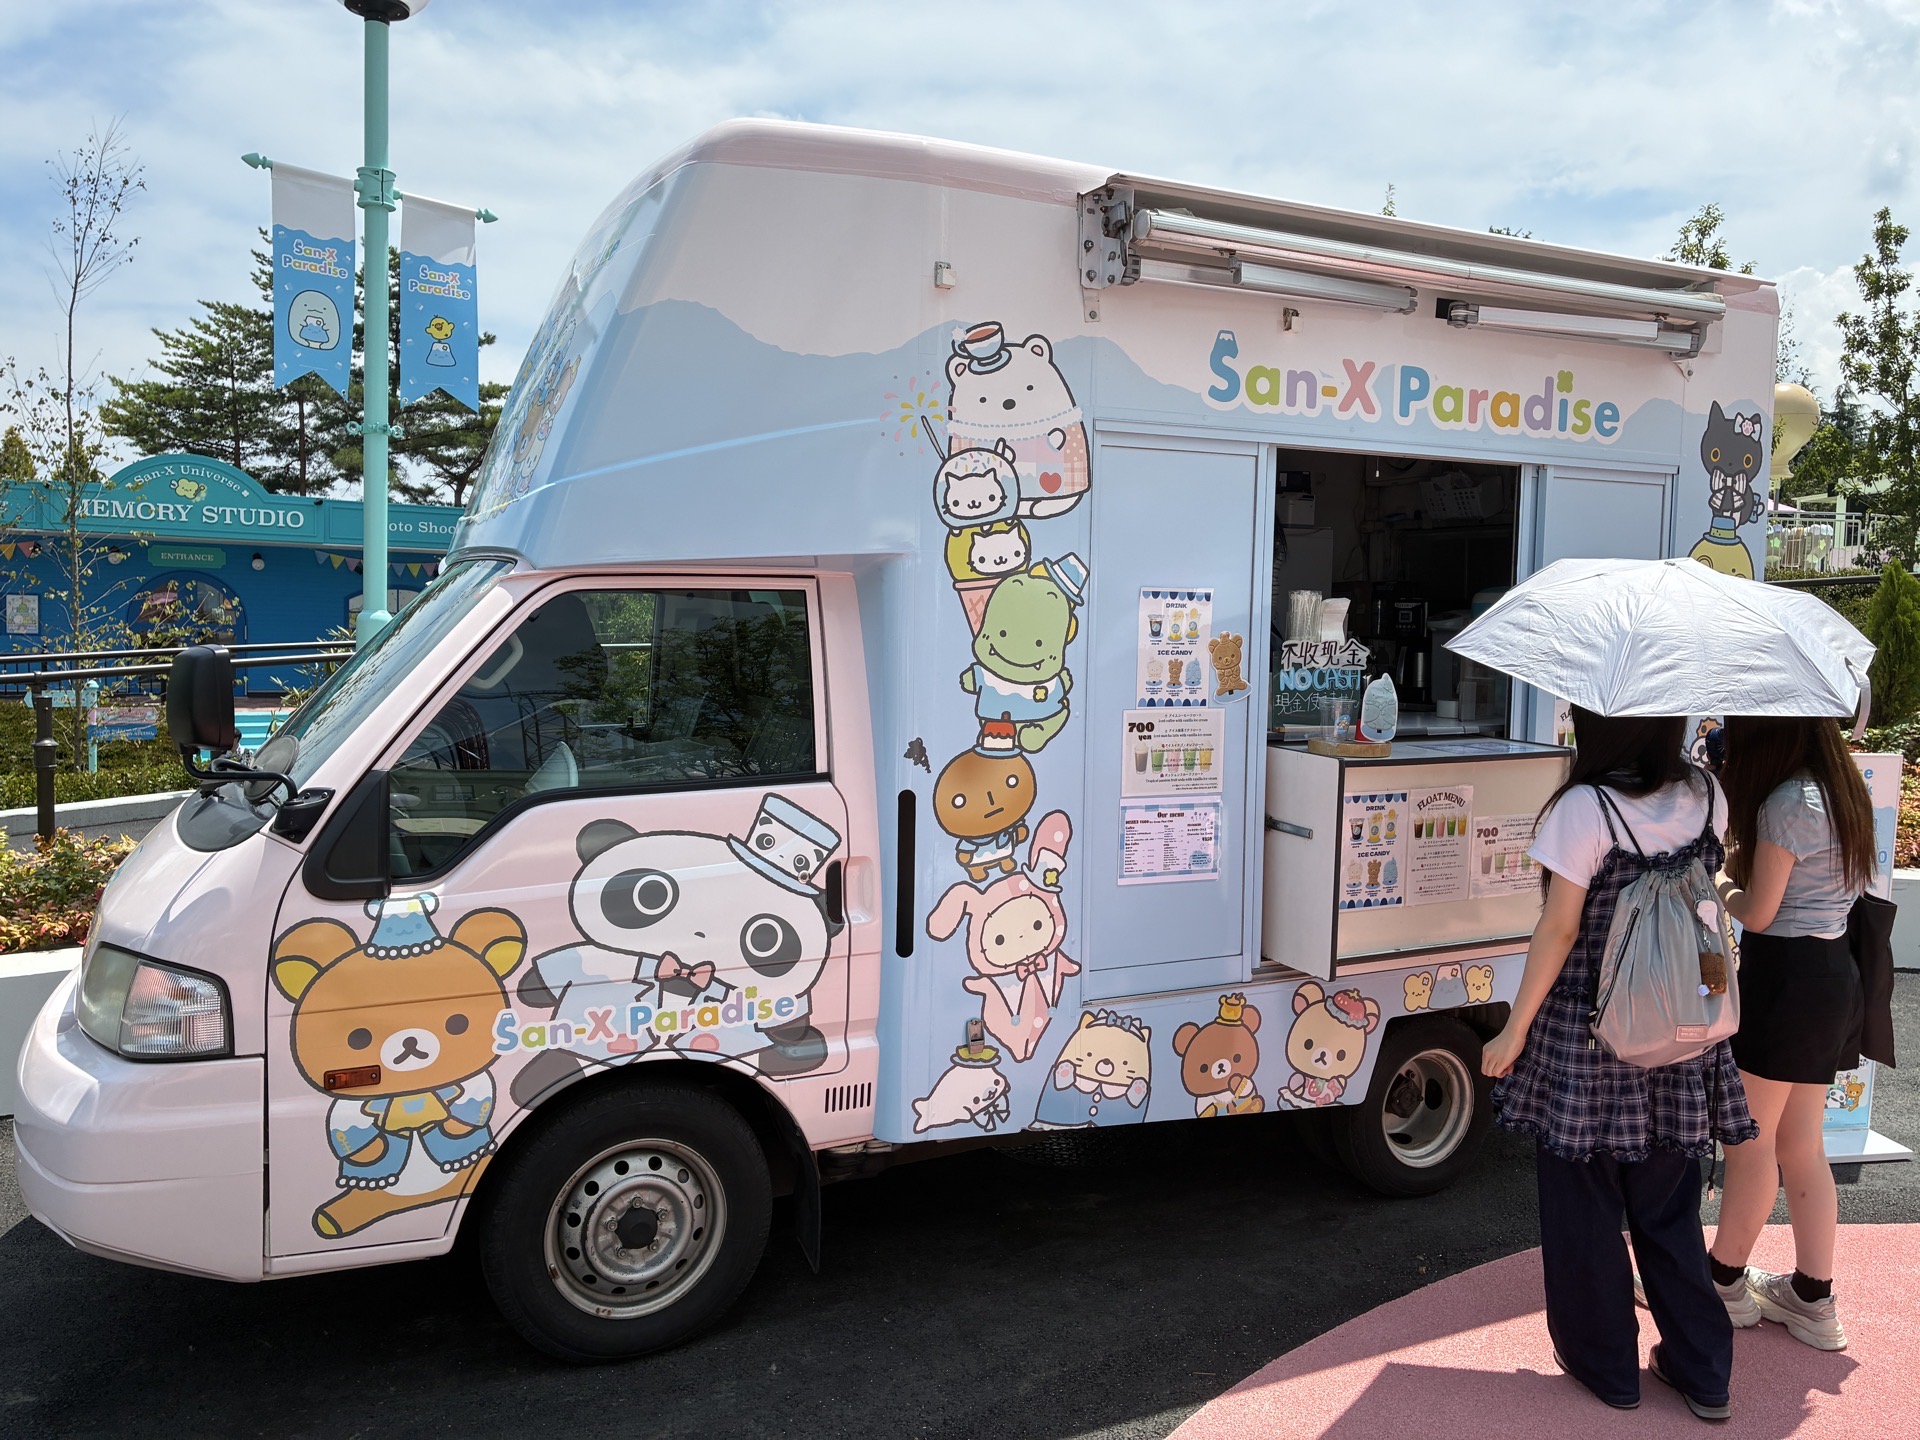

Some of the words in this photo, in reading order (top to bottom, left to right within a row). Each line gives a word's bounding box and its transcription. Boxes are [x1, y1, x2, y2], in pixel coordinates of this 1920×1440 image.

[294, 240, 337, 261] San-X
[282, 254, 348, 278] Paradise
[420, 266, 460, 284] San-X
[409, 279, 470, 300] Paradise
[1207, 329, 1376, 415] San-X
[1400, 365, 1621, 438] Paradise
[134, 465, 175, 486] San-X
[179, 464, 242, 492] Universe
[65, 496, 194, 523] MEMORY
[201, 505, 305, 528] STUDIO
[388, 521, 413, 532] oto
[418, 521, 457, 534] Shoo
[160, 552, 214, 562] ENTRANCE
[1282, 640, 1369, 669] 不收现金
[1280, 667, 1312, 692] NO
[1313, 667, 1361, 691] CASH
[1128, 722, 1155, 733] 700
[1365, 804, 1386, 812] DRINK
[1417, 792, 1443, 811] FLOAT
[1443, 792, 1466, 808] MENU
[1476, 827, 1499, 838] 700
[1484, 838, 1496, 846] yen
[495, 1008, 617, 1052] San-X
[629, 985, 796, 1036] Paradise
